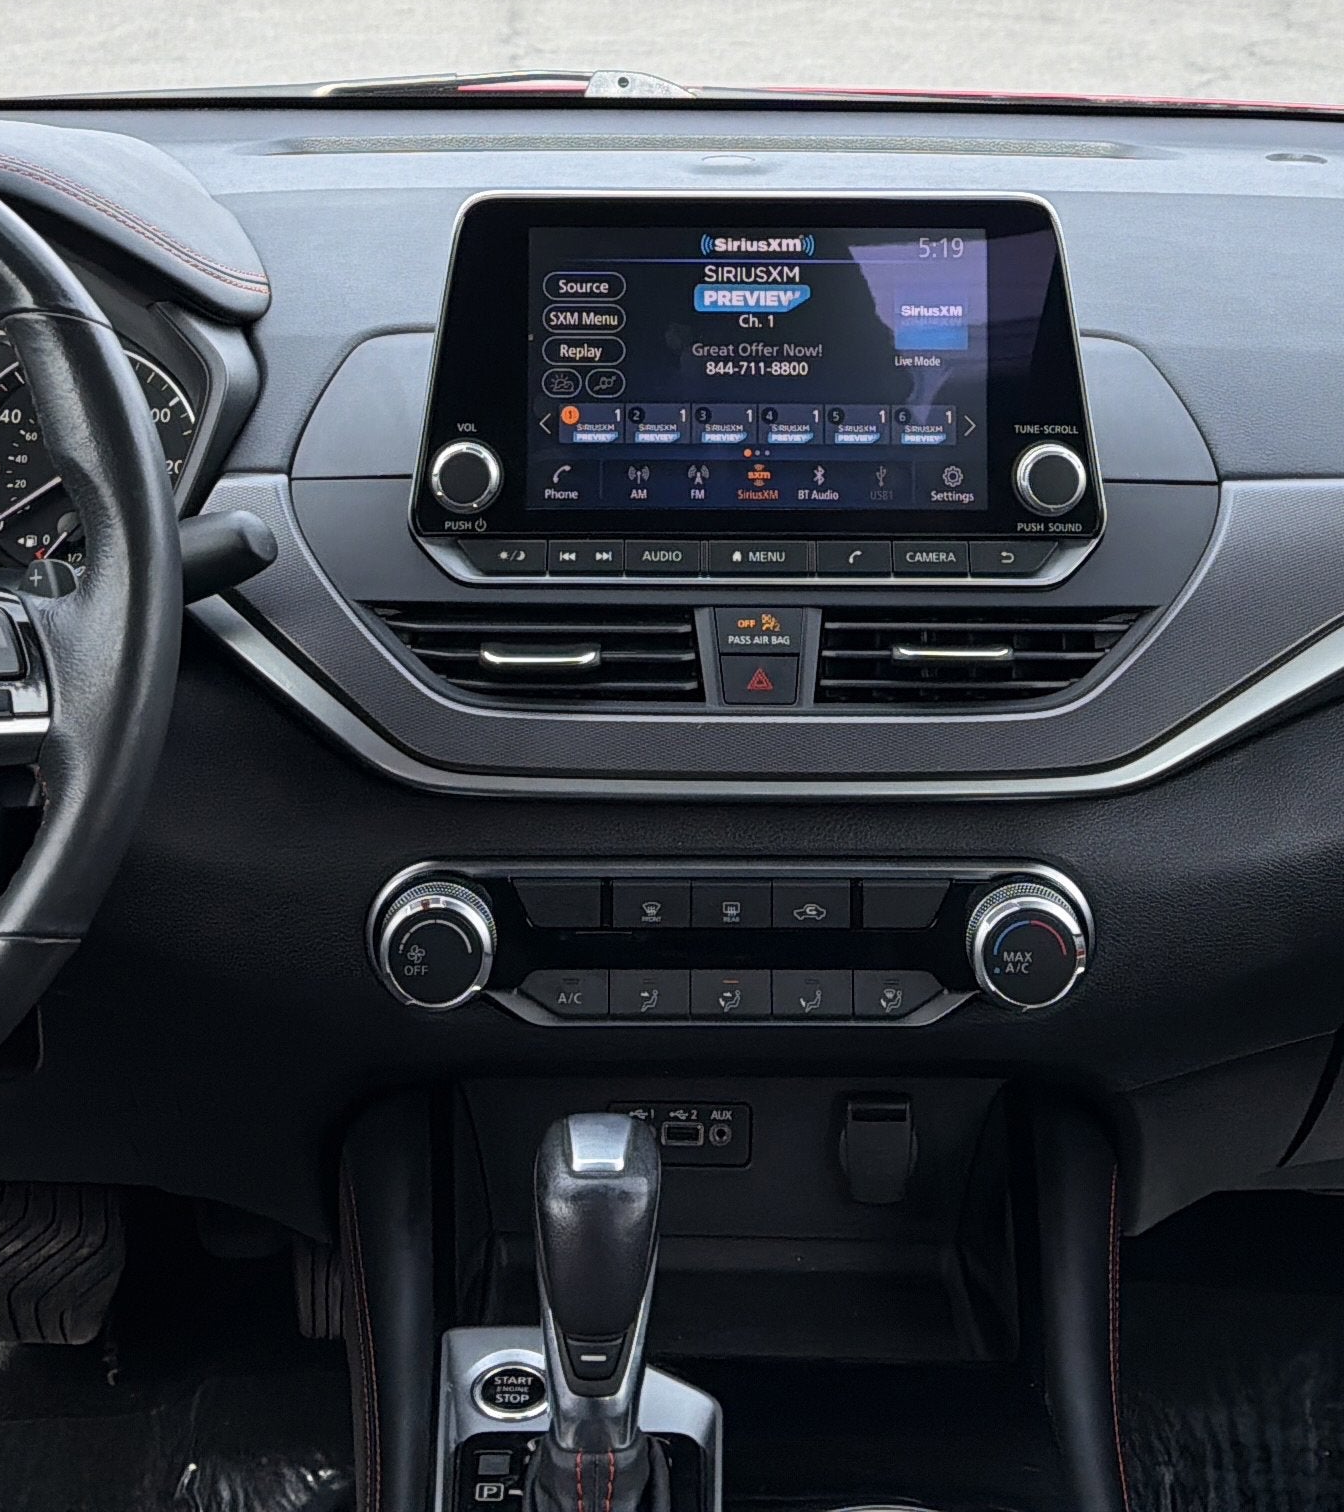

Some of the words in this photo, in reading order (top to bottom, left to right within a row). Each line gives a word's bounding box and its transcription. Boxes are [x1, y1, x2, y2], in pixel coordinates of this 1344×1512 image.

[918, 237, 965, 258] 5:19
[704, 265, 801, 283] SIRIUSXM
[559, 280, 609, 294] Source
[703, 290, 801, 306] PREVIEW
[900, 305, 963, 317] SiriusXM
[549, 311, 579, 326] SXM
[582, 312, 618, 326] Menu
[738, 315, 763, 328] Ch.
[768, 315, 775, 328] 1
[559, 343, 603, 361] Replay
[692, 344, 735, 357] Great
[738, 343, 780, 357] Offer
[783, 344, 823, 357] Now!
[895, 356, 913, 368] Live
[914, 356, 941, 368] Mode
[706, 362, 809, 376] 844-711-8800
[0, 409, 22, 423] 40
[614, 409, 621, 422] 1
[632, 411, 641, 420] 2
[679, 409, 686, 422] 1
[699, 411, 707, 420] 3
[746, 409, 753, 422] 1
[765, 411, 774, 420] 4
[812, 409, 819, 422] 1
[832, 411, 840, 420] 5
[879, 410, 886, 423] 1
[898, 411, 907, 421] 6
[946, 410, 953, 424] 1
[457, 423, 477, 433] VOL
[25, 432, 37, 441] 60
[15, 455, 28, 463] 40
[14, 479, 27, 488] 20
[544, 489, 578, 500] Phone
[630, 489, 647, 499] AM
[691, 489, 705, 499] FM
[737, 489, 779, 500] SiriusXM
[798, 489, 812, 500] BT
[813, 489, 839, 500] Audio
[931, 490, 975, 503] Settings
[444, 520, 472, 531] PUSH
[1017, 522, 1045, 532] PUSH
[1048, 523, 1082, 532] SOUND
[642, 550, 682, 563] AUDIO
[748, 551, 786, 562] MENU
[906, 552, 956, 563] CAMERA
[737, 619, 756, 628] OFF
[728, 635, 752, 645] PASS
[752, 635, 770, 645] AIR
[771, 635, 791, 646] BAG
[1003, 951, 1033, 963] MAX
[403, 965, 429, 976] OFF
[1005, 962, 1030, 974] A/C
[557, 992, 583, 1004] A/C
[690, 1109, 697, 1119] 2
[710, 1110, 733, 1120] AUX
[493, 1375, 534, 1386] START
[494, 1393, 530, 1404] STOP
[483, 1486, 498, 1498] P
